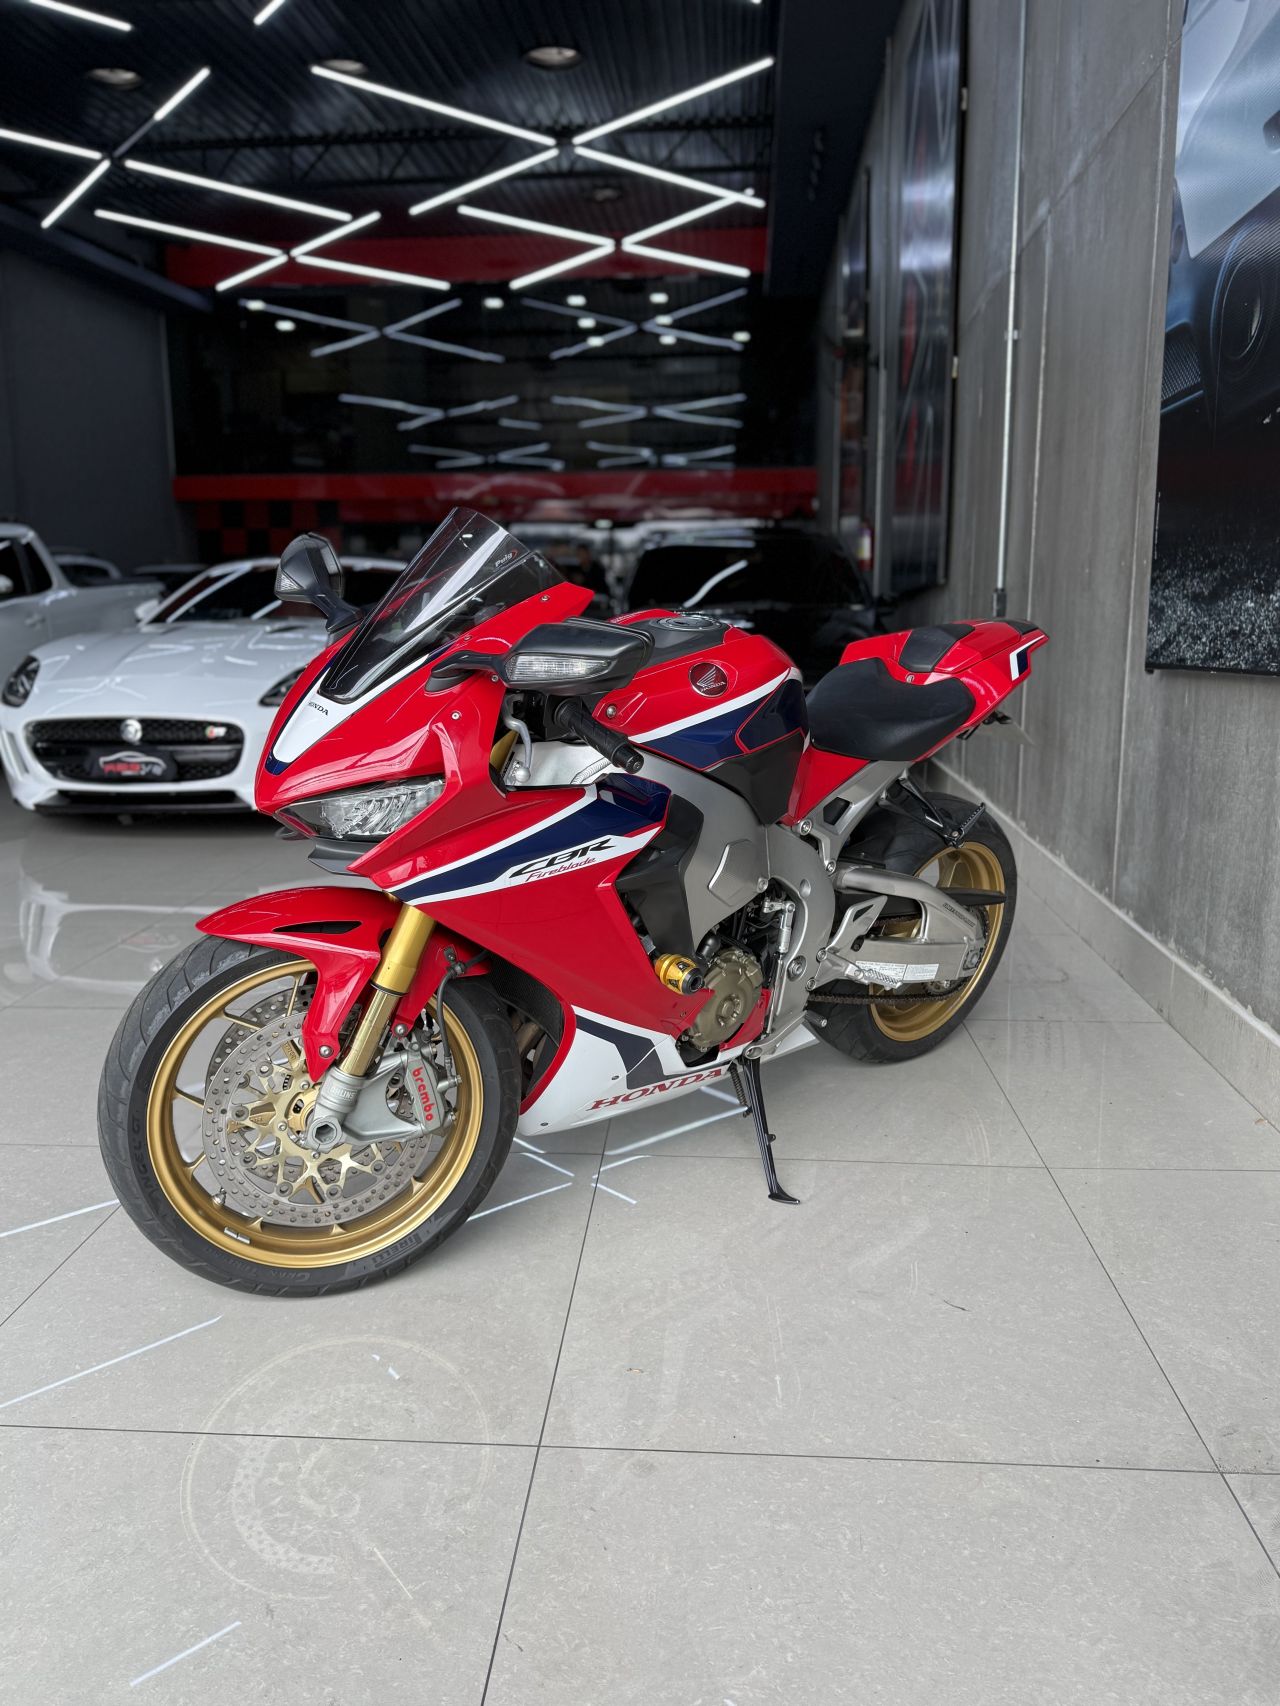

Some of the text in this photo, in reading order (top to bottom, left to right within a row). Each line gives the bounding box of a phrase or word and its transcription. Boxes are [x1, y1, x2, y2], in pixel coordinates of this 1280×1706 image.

[509, 838, 616, 879] CBR
[525, 857, 597, 882] Fireblade
[412, 1066, 436, 1122] brembo
[586, 1068, 722, 1111] HONDA
